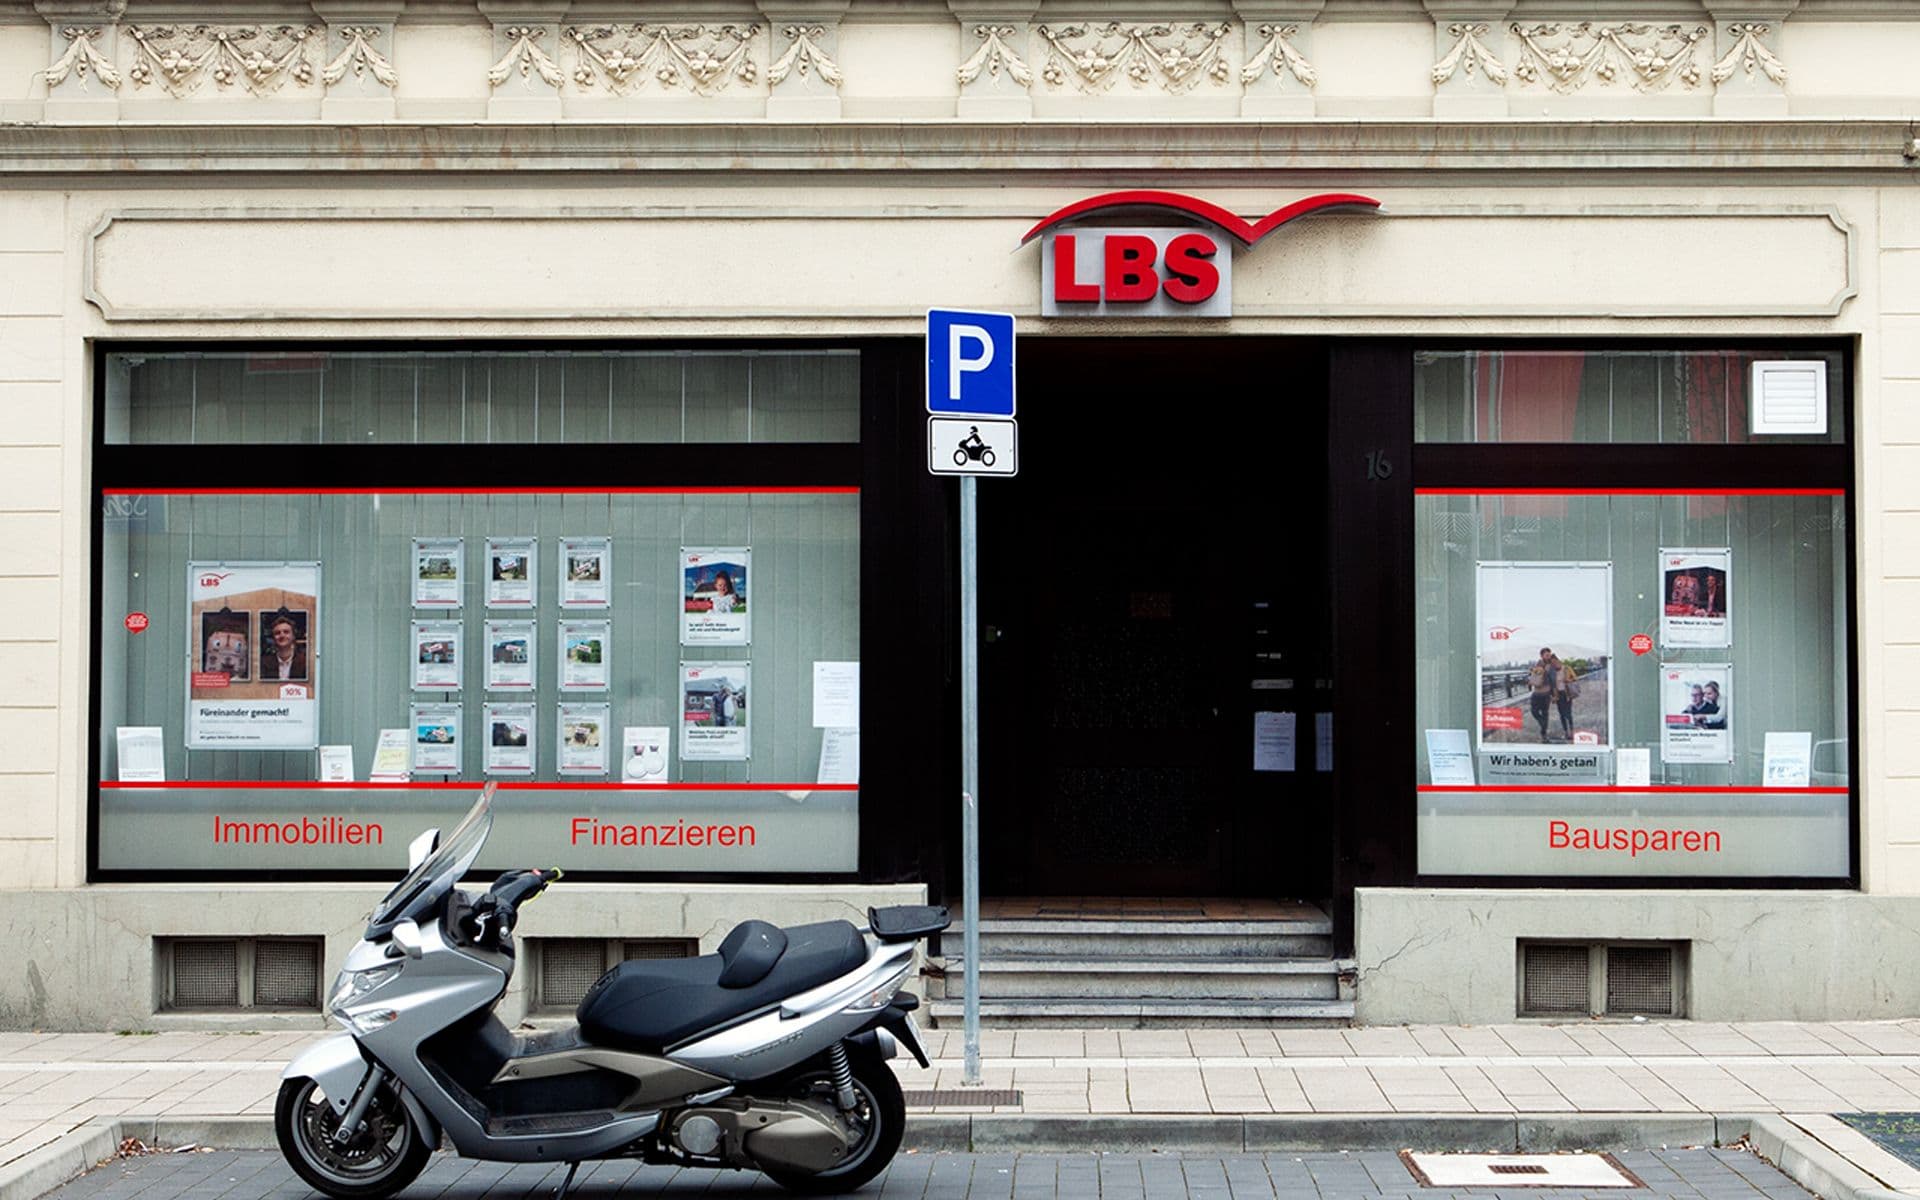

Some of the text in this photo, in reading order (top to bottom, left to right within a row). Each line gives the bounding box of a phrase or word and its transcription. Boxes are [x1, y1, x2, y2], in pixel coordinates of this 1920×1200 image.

[1053, 233, 1220, 303] LBS
[949, 324, 994, 400] P
[1365, 450, 1393, 481] 16
[200, 578, 220, 587] LBS
[1489, 631, 1511, 641] LBS
[200, 708, 289, 719] Füreinander gemacht!
[1490, 755, 1597, 770] Wir haben's getan!
[214, 816, 383, 845] Immobilien
[571, 818, 756, 847] Finanzieren
[1548, 820, 1722, 857] Bausparen
